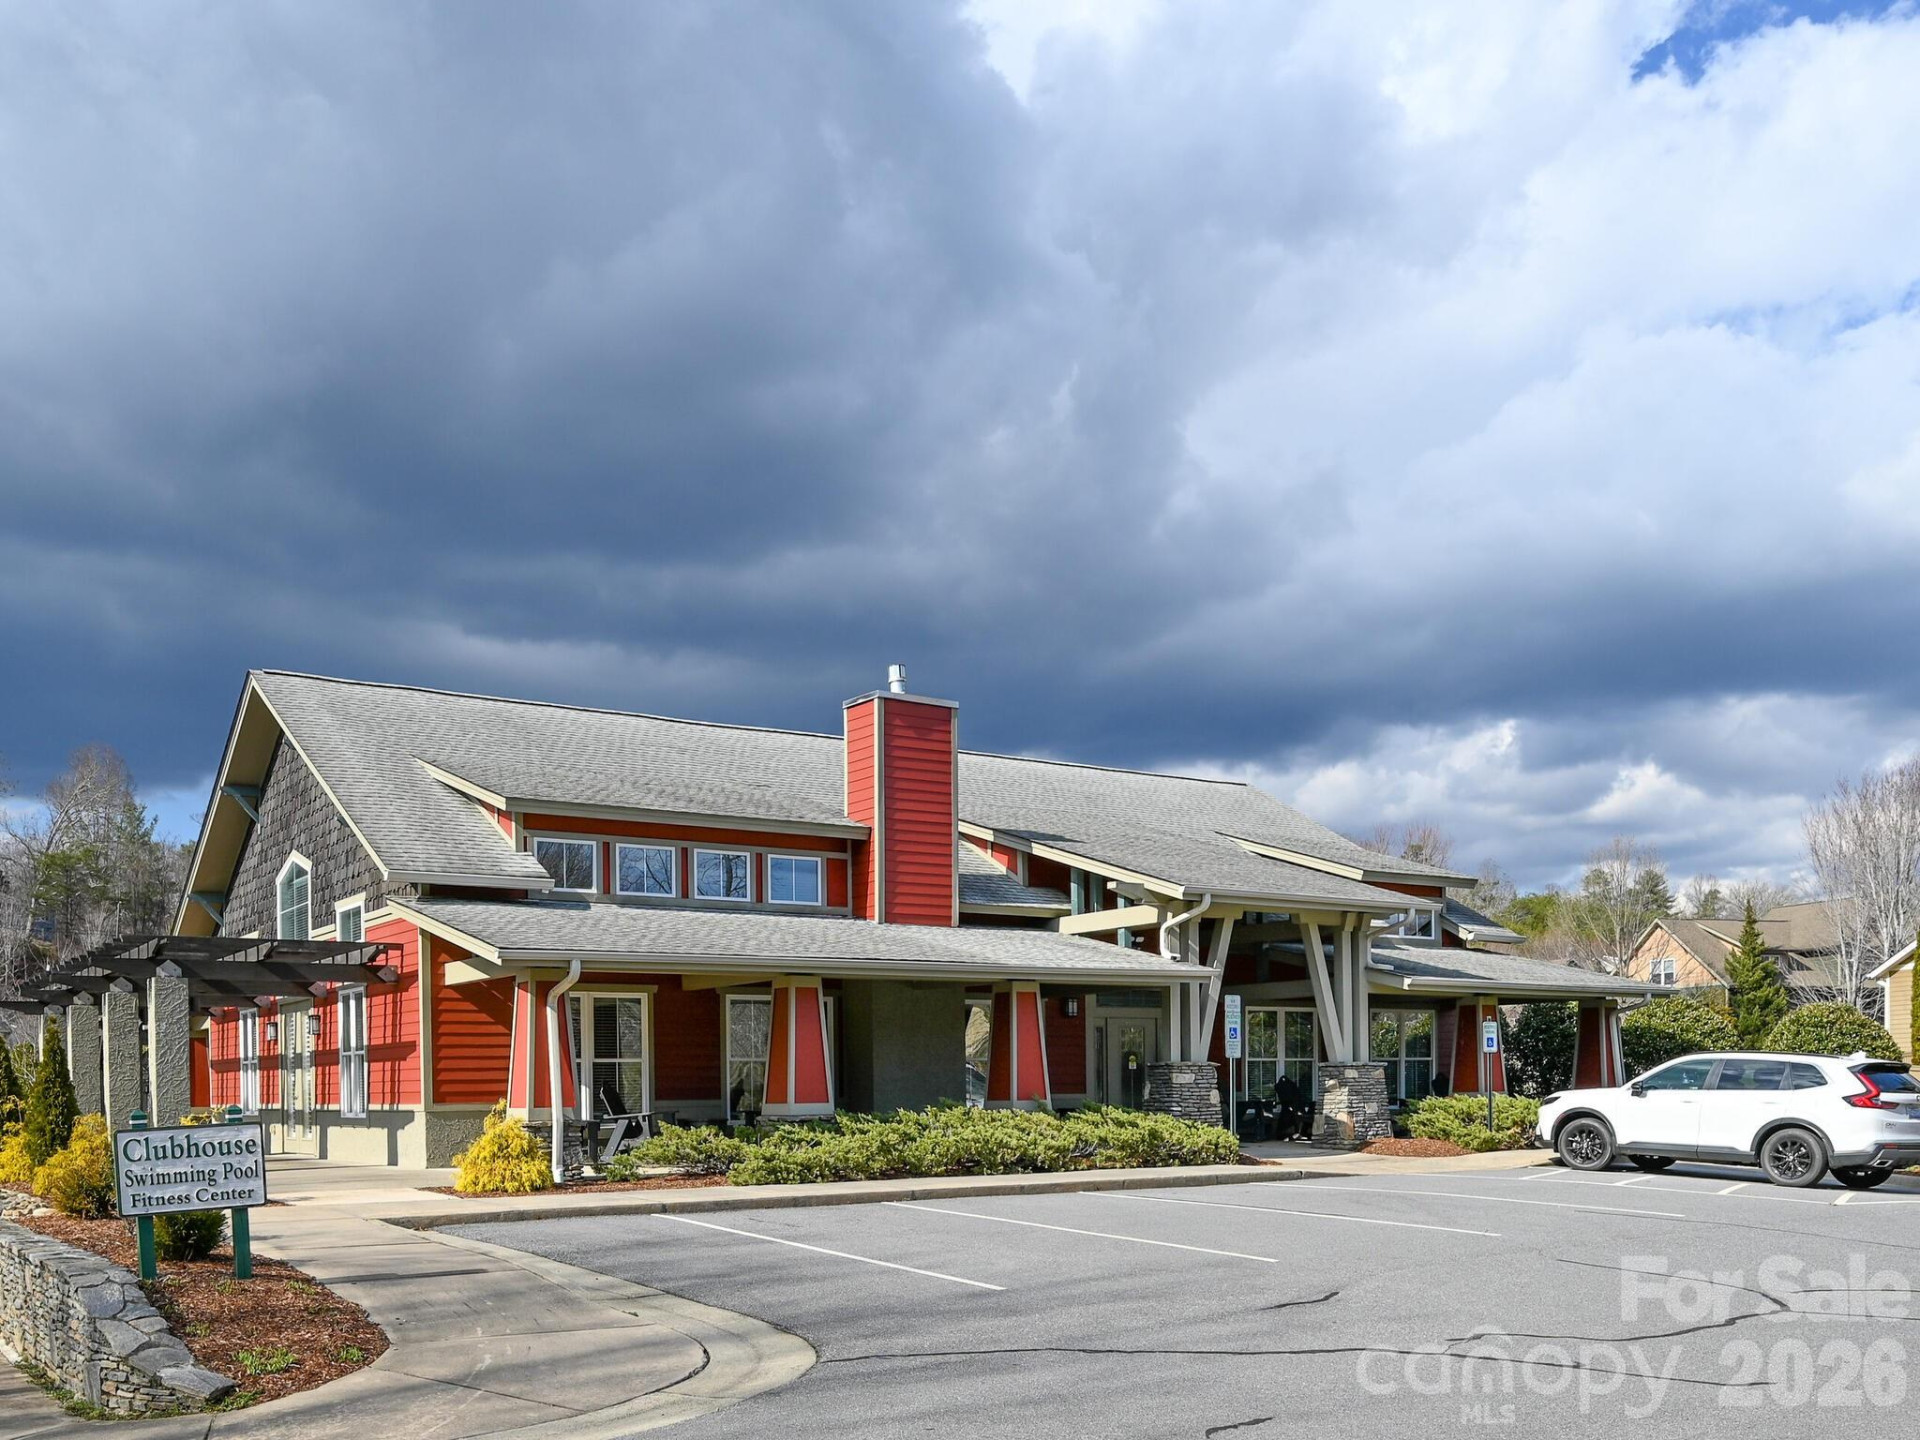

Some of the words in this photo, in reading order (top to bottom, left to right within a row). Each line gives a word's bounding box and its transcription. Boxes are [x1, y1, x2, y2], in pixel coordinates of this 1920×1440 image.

[122, 1134, 257, 1163] Clubhouse
[124, 1165, 217, 1187] Swimming
[222, 1160, 259, 1180] Pool
[130, 1192, 190, 1208] Fitness
[195, 1188, 255, 1203] Center
